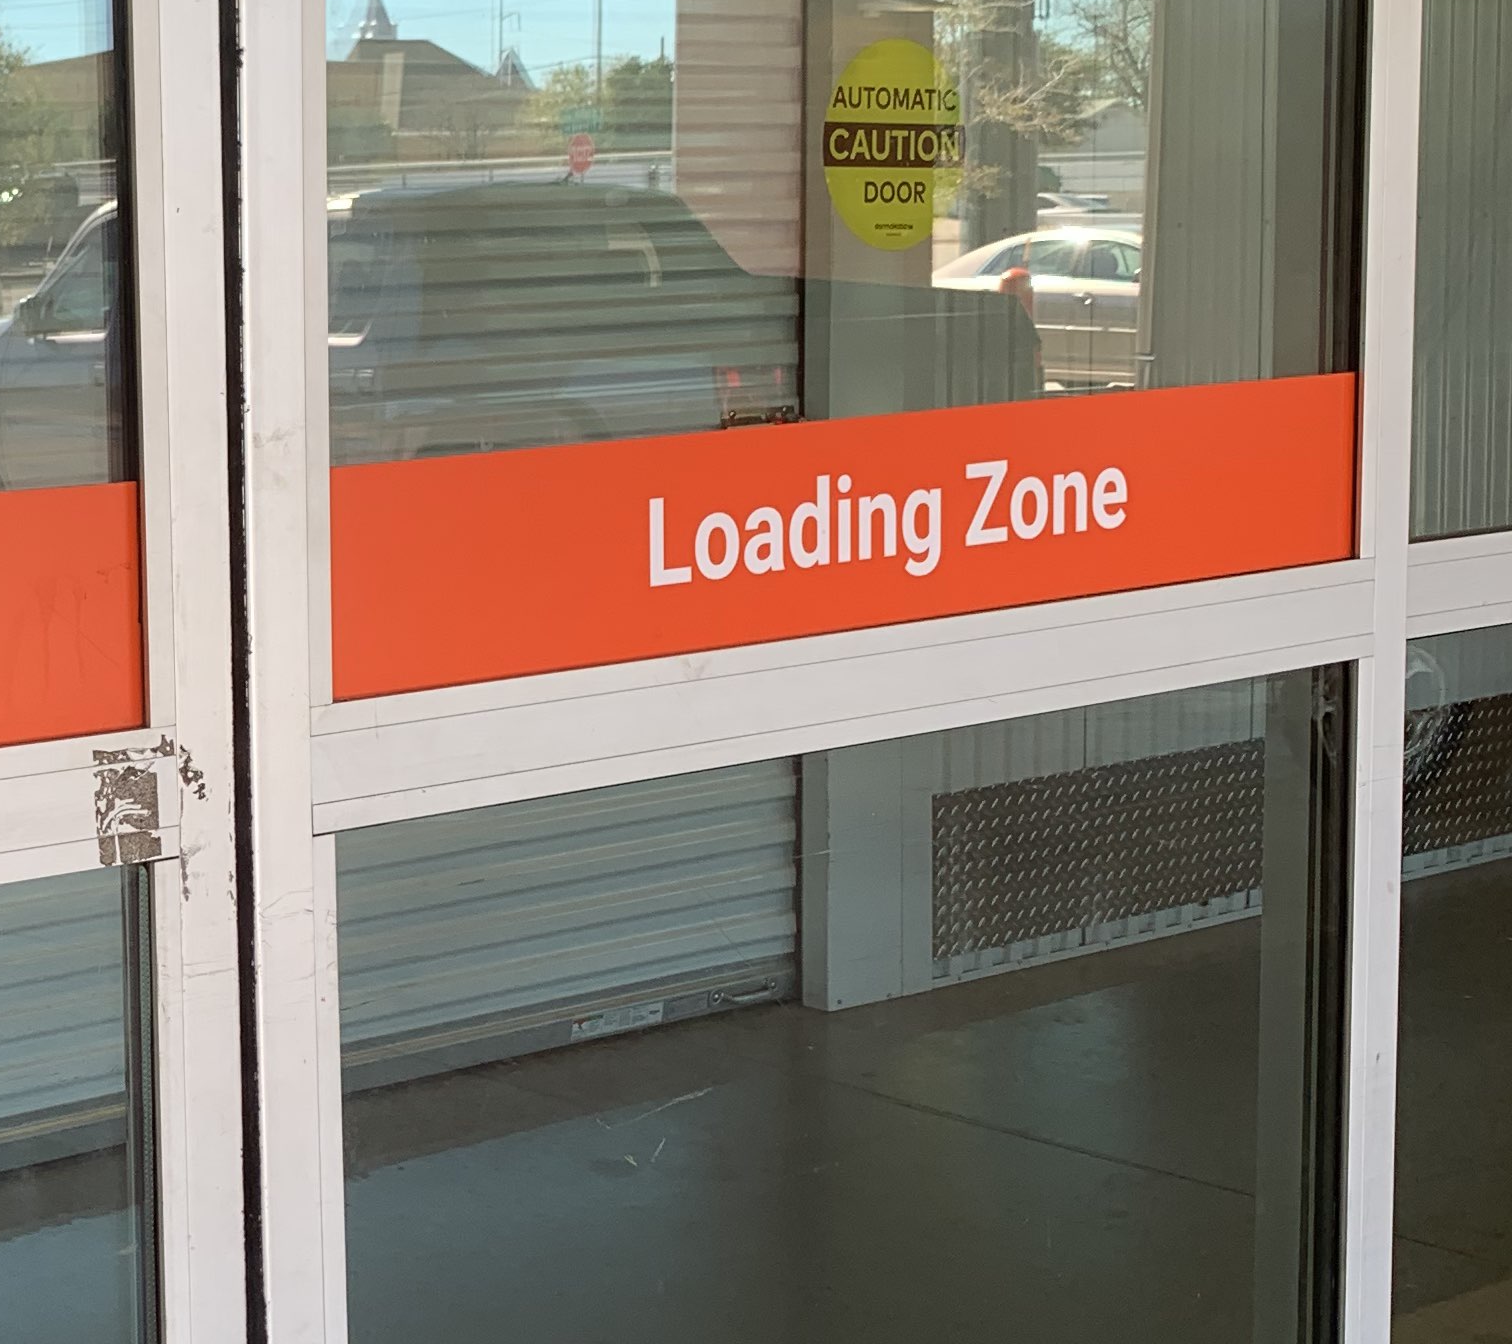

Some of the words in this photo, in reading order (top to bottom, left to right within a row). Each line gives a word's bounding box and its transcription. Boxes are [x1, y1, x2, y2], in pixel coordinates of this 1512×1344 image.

[832, 86, 958, 112] AUTOMATIC
[829, 128, 960, 162] CAUTION
[863, 181, 927, 204] DOOR
[649, 473, 942, 587] Loading
[965, 459, 1129, 547] Zone
